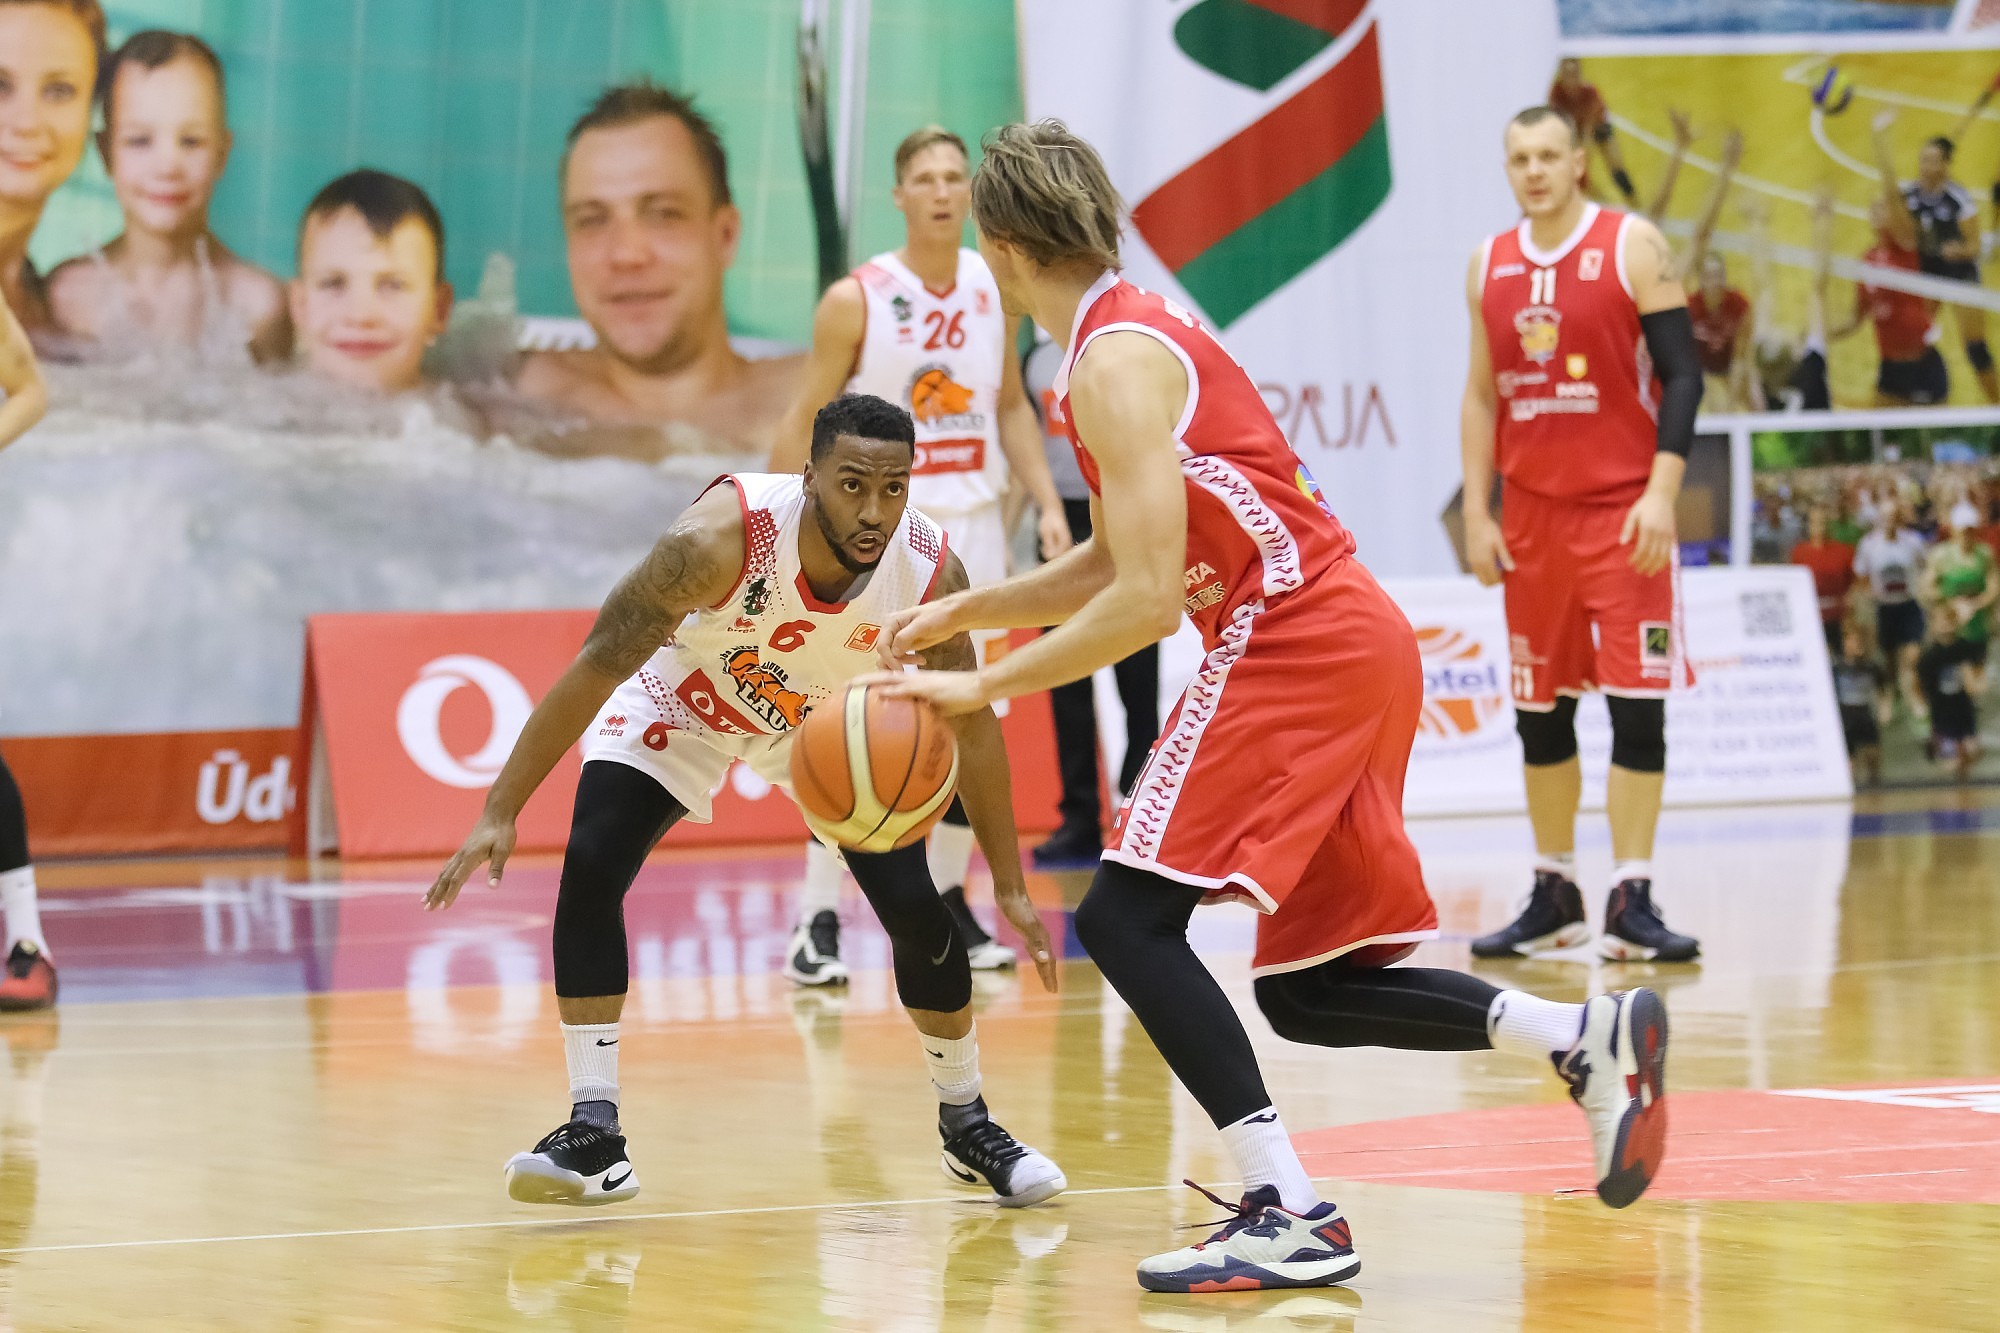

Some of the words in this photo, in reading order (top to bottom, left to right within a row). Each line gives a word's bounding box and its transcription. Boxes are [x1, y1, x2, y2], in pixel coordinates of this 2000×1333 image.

[1530, 267, 1557, 305] 11
[923, 310, 966, 350] 26
[1184, 562, 1217, 590] ATA
[768, 619, 817, 653] 6
[1424, 665, 1497, 691] otel
[736, 680, 792, 731] LAU
[599, 728, 624, 737] errea
[643, 721, 683, 752] 6
[196, 749, 297, 824] Ūd
